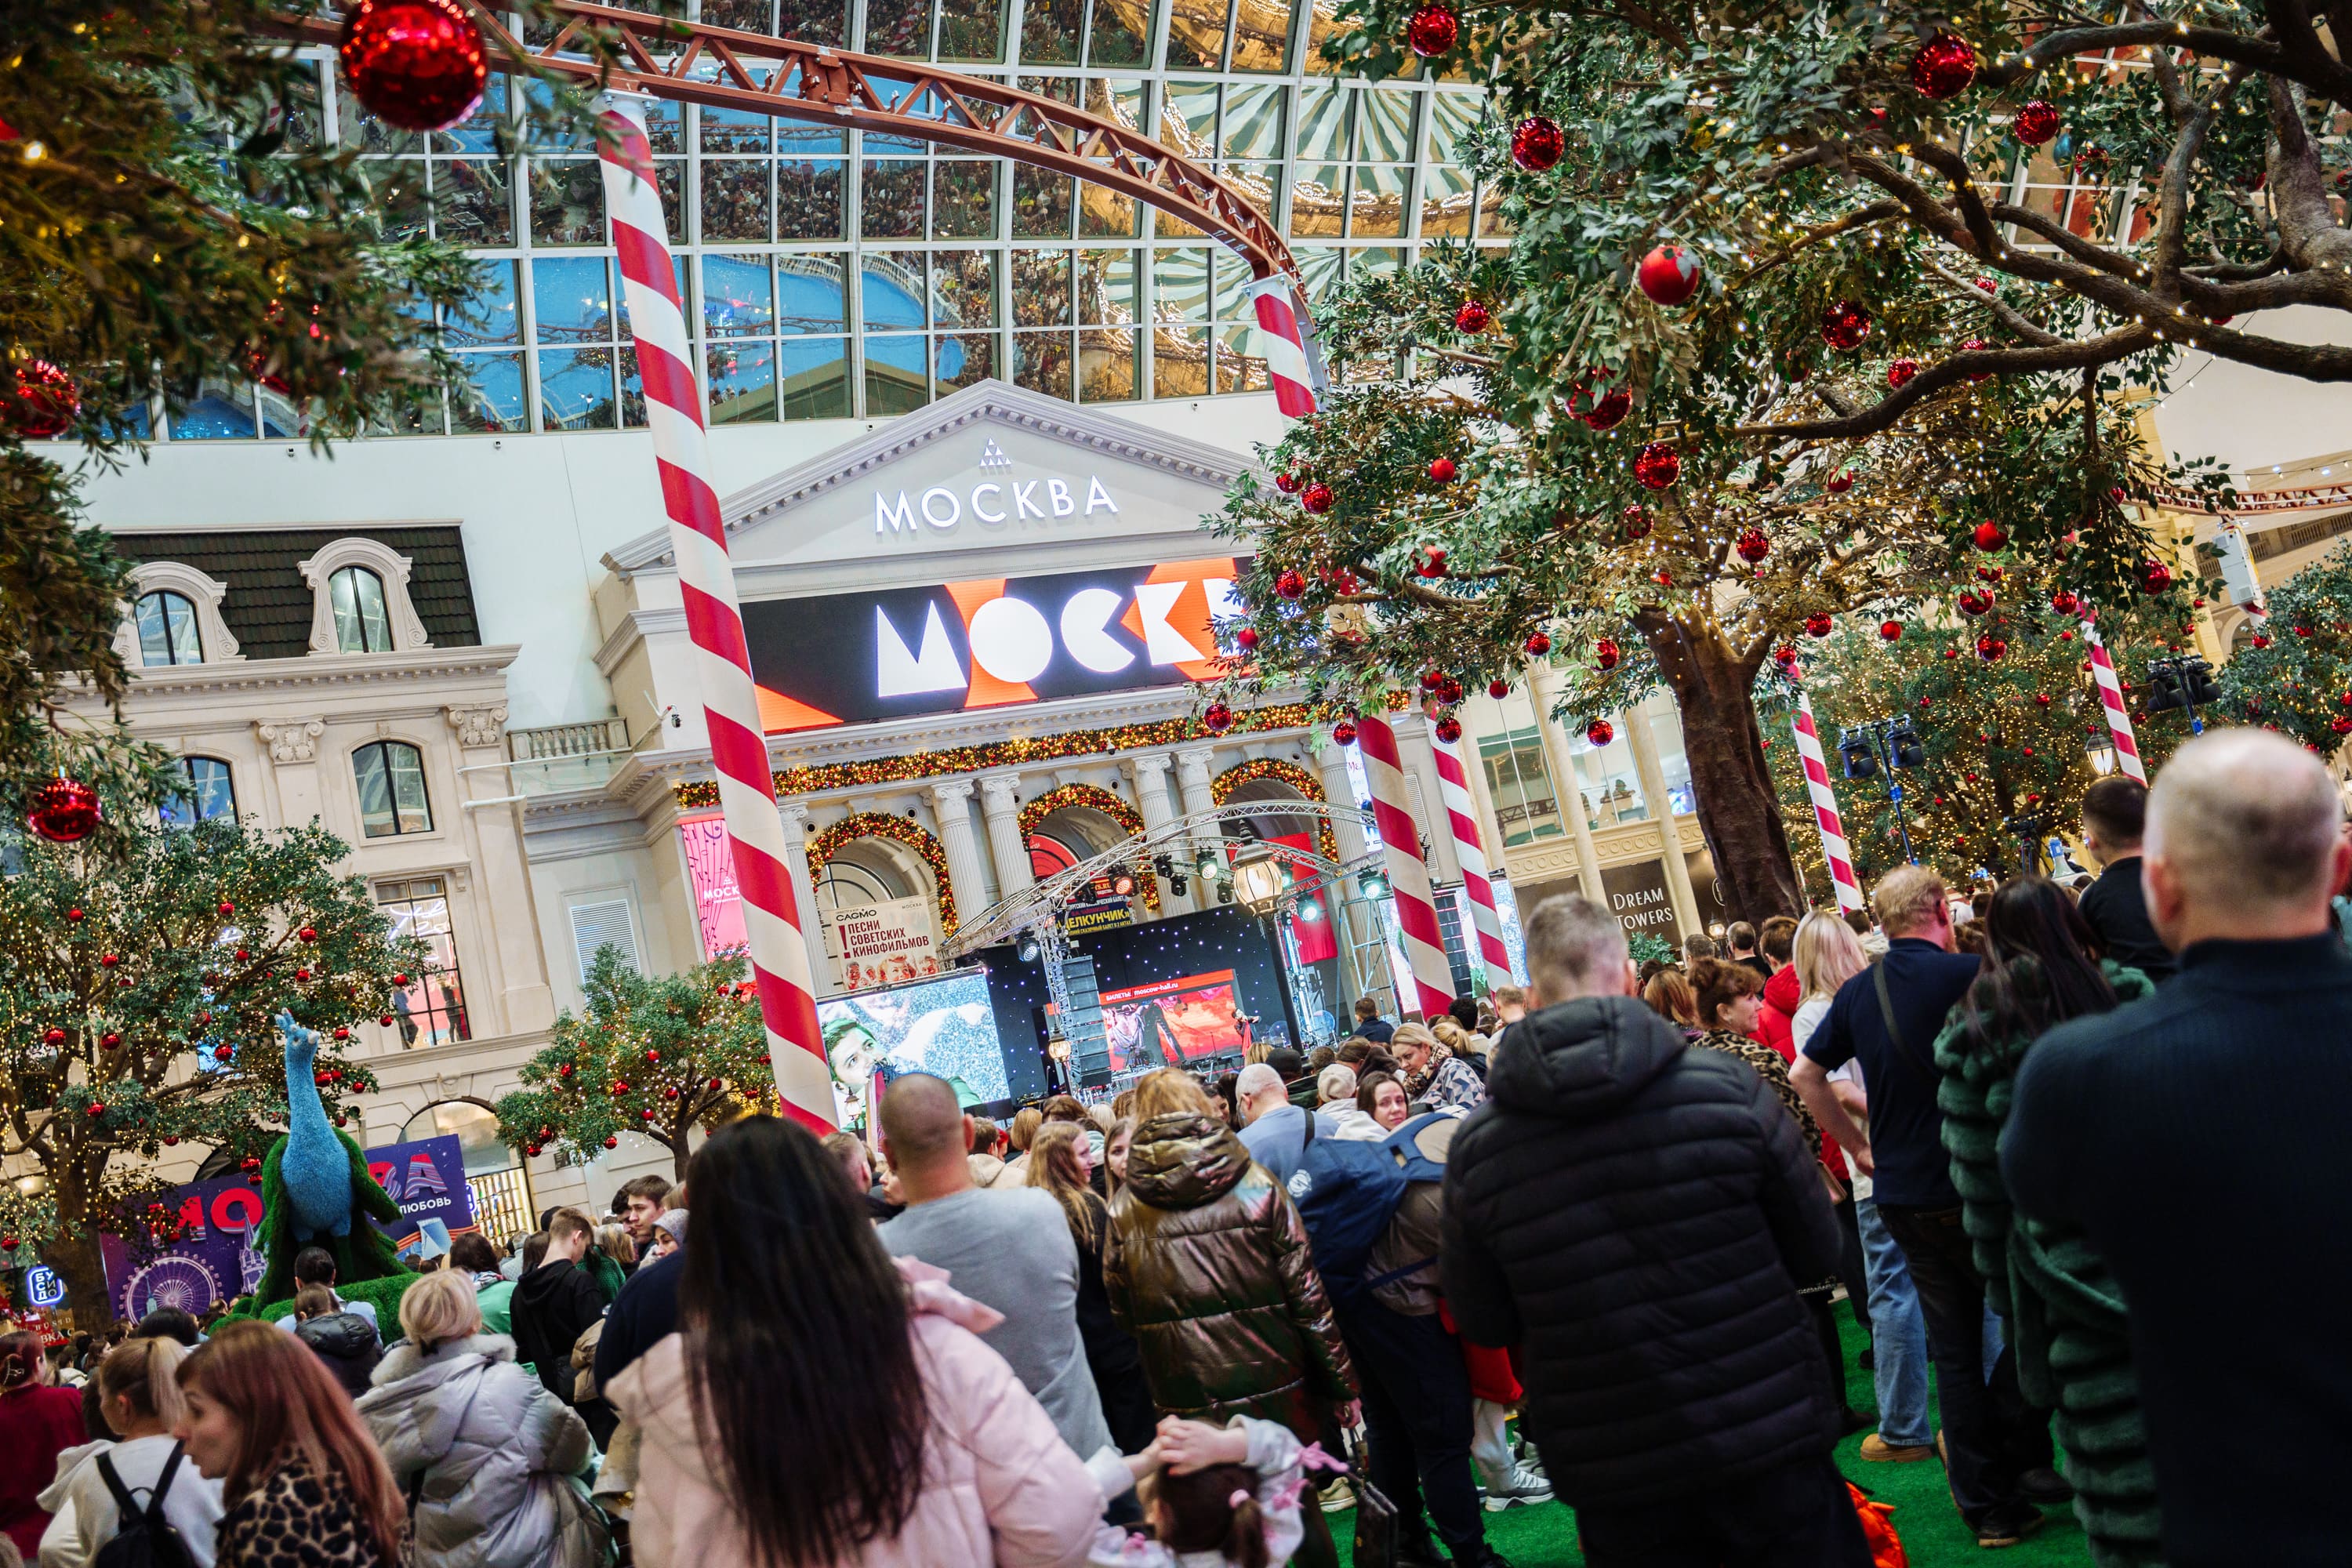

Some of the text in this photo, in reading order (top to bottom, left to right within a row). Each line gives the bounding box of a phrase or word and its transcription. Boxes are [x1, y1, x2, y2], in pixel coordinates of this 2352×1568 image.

[875, 474, 1120, 533] МОСКВА
[1613, 887, 1664, 910] DREAM
[848, 920, 880, 935] ПЕСНИ
[1615, 907, 1673, 931] TOWERS
[851, 927, 906, 946] СОВЕТСКИХ
[852, 935, 929, 958] КИНОФИЛЬМОВ
[1134, 982, 1178, 996] moscow-hall.ru
